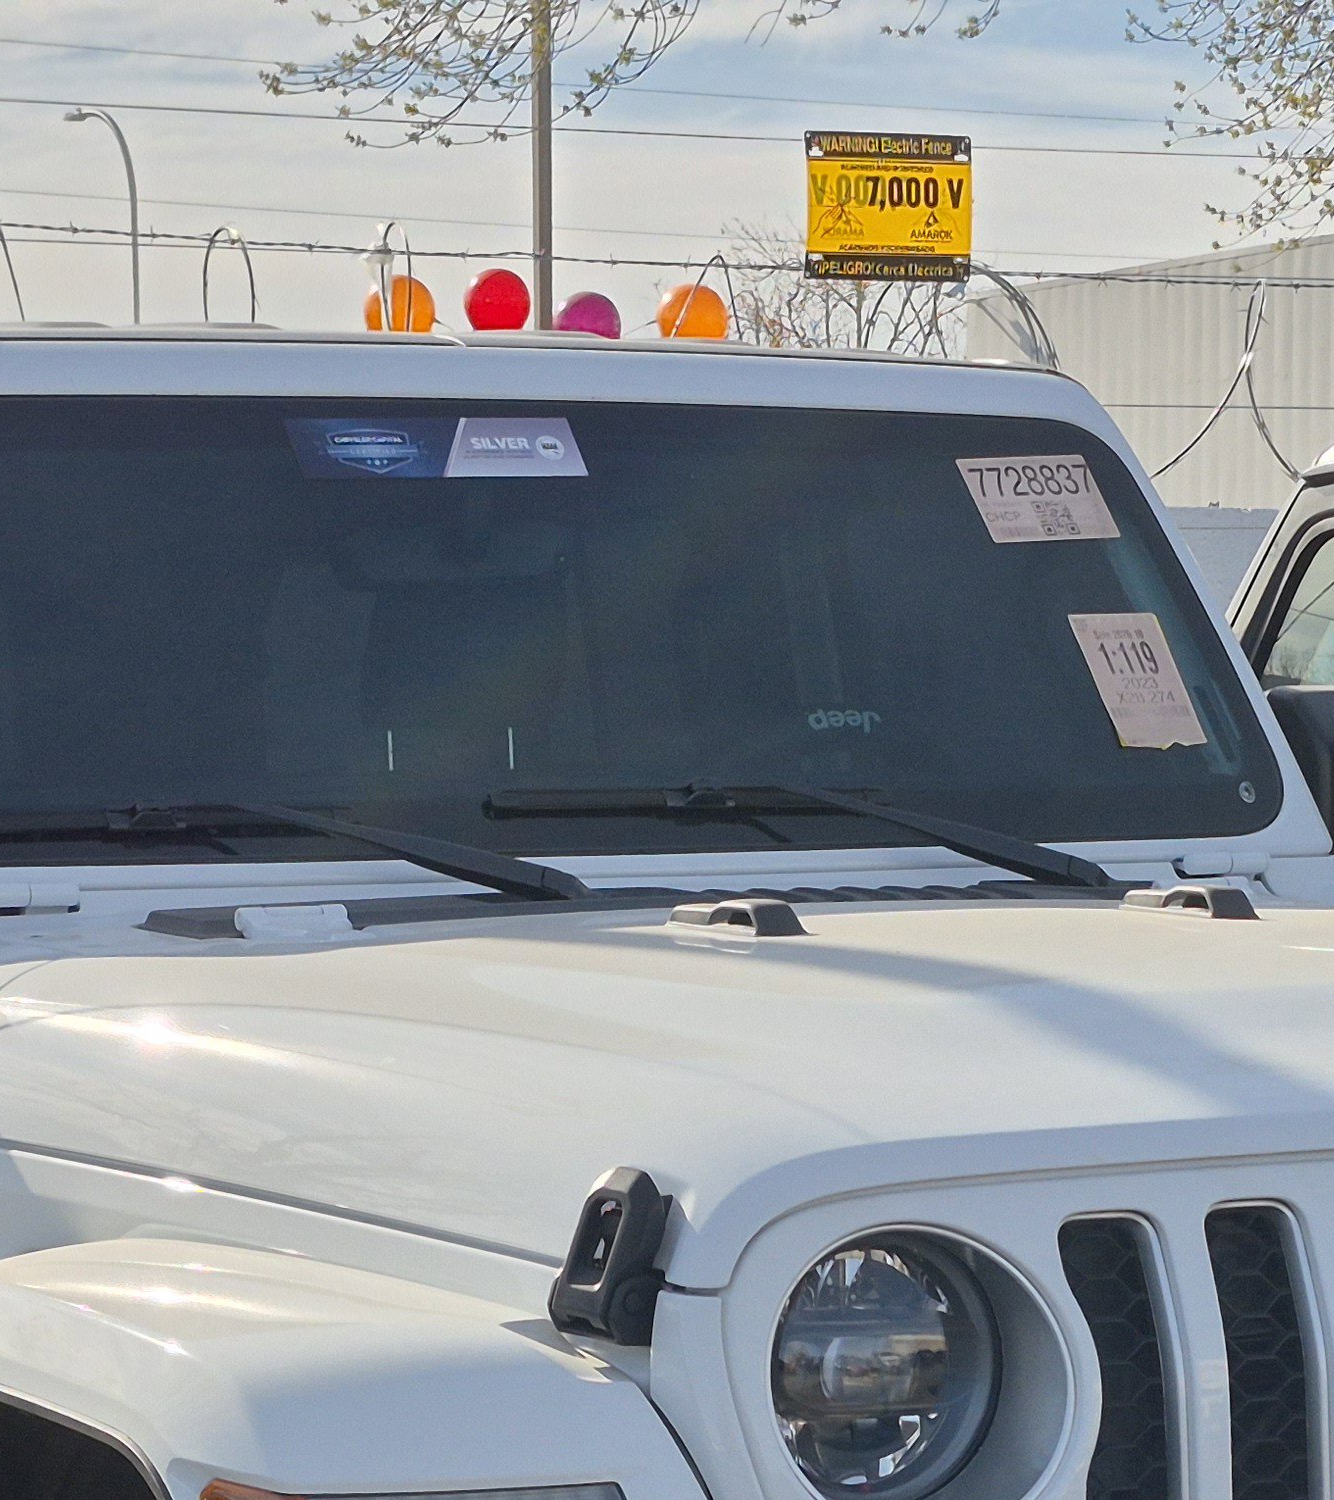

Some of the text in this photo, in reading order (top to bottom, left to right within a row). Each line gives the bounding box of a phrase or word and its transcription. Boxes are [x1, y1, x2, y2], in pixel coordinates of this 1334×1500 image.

[881, 136, 920, 155] Electric
[922, 138, 953, 156] Fence
[865, 176, 965, 211] 7,000 V
[910, 229, 953, 240] AMAROK
[470, 437, 530, 450] SILVER
[967, 464, 1091, 497] 7728837
[985, 511, 1021, 523] CHCP
[1098, 640, 1160, 675] 1:119
[1121, 677, 1159, 690] 2023
